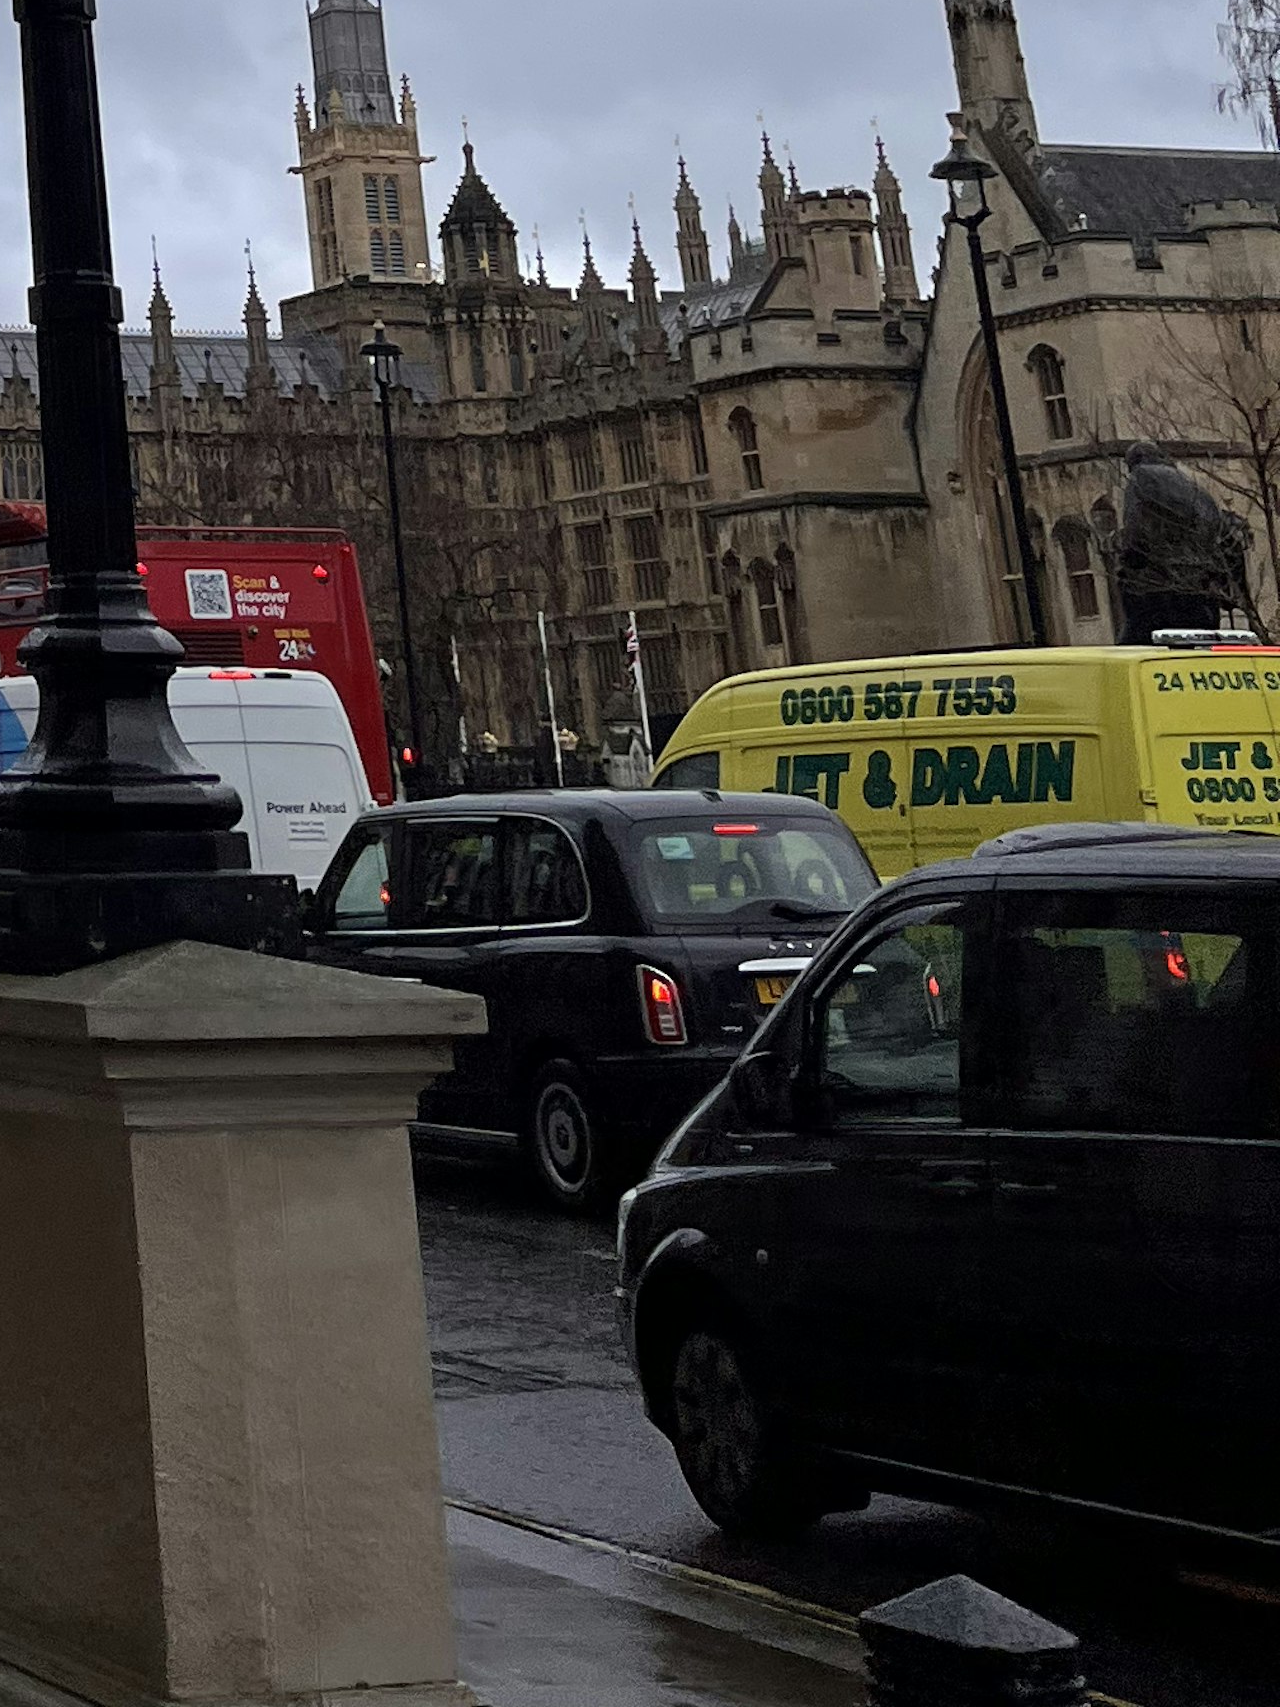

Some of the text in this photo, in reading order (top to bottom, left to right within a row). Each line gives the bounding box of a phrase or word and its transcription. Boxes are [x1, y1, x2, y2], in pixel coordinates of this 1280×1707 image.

[232, 575, 280, 589] Scan &
[235, 589, 290, 604] discover
[237, 603, 286, 619] the city
[1153, 672, 1184, 691] 24
[1190, 671, 1259, 690] HOUR
[780, 675, 1017, 725] 0800 587 7553
[1181, 742, 1273, 770] JET &
[762, 740, 1076, 809] JET & DRAIN
[1187, 777, 1280, 803] 0800 5
[266, 801, 347, 813] Power Ahead
